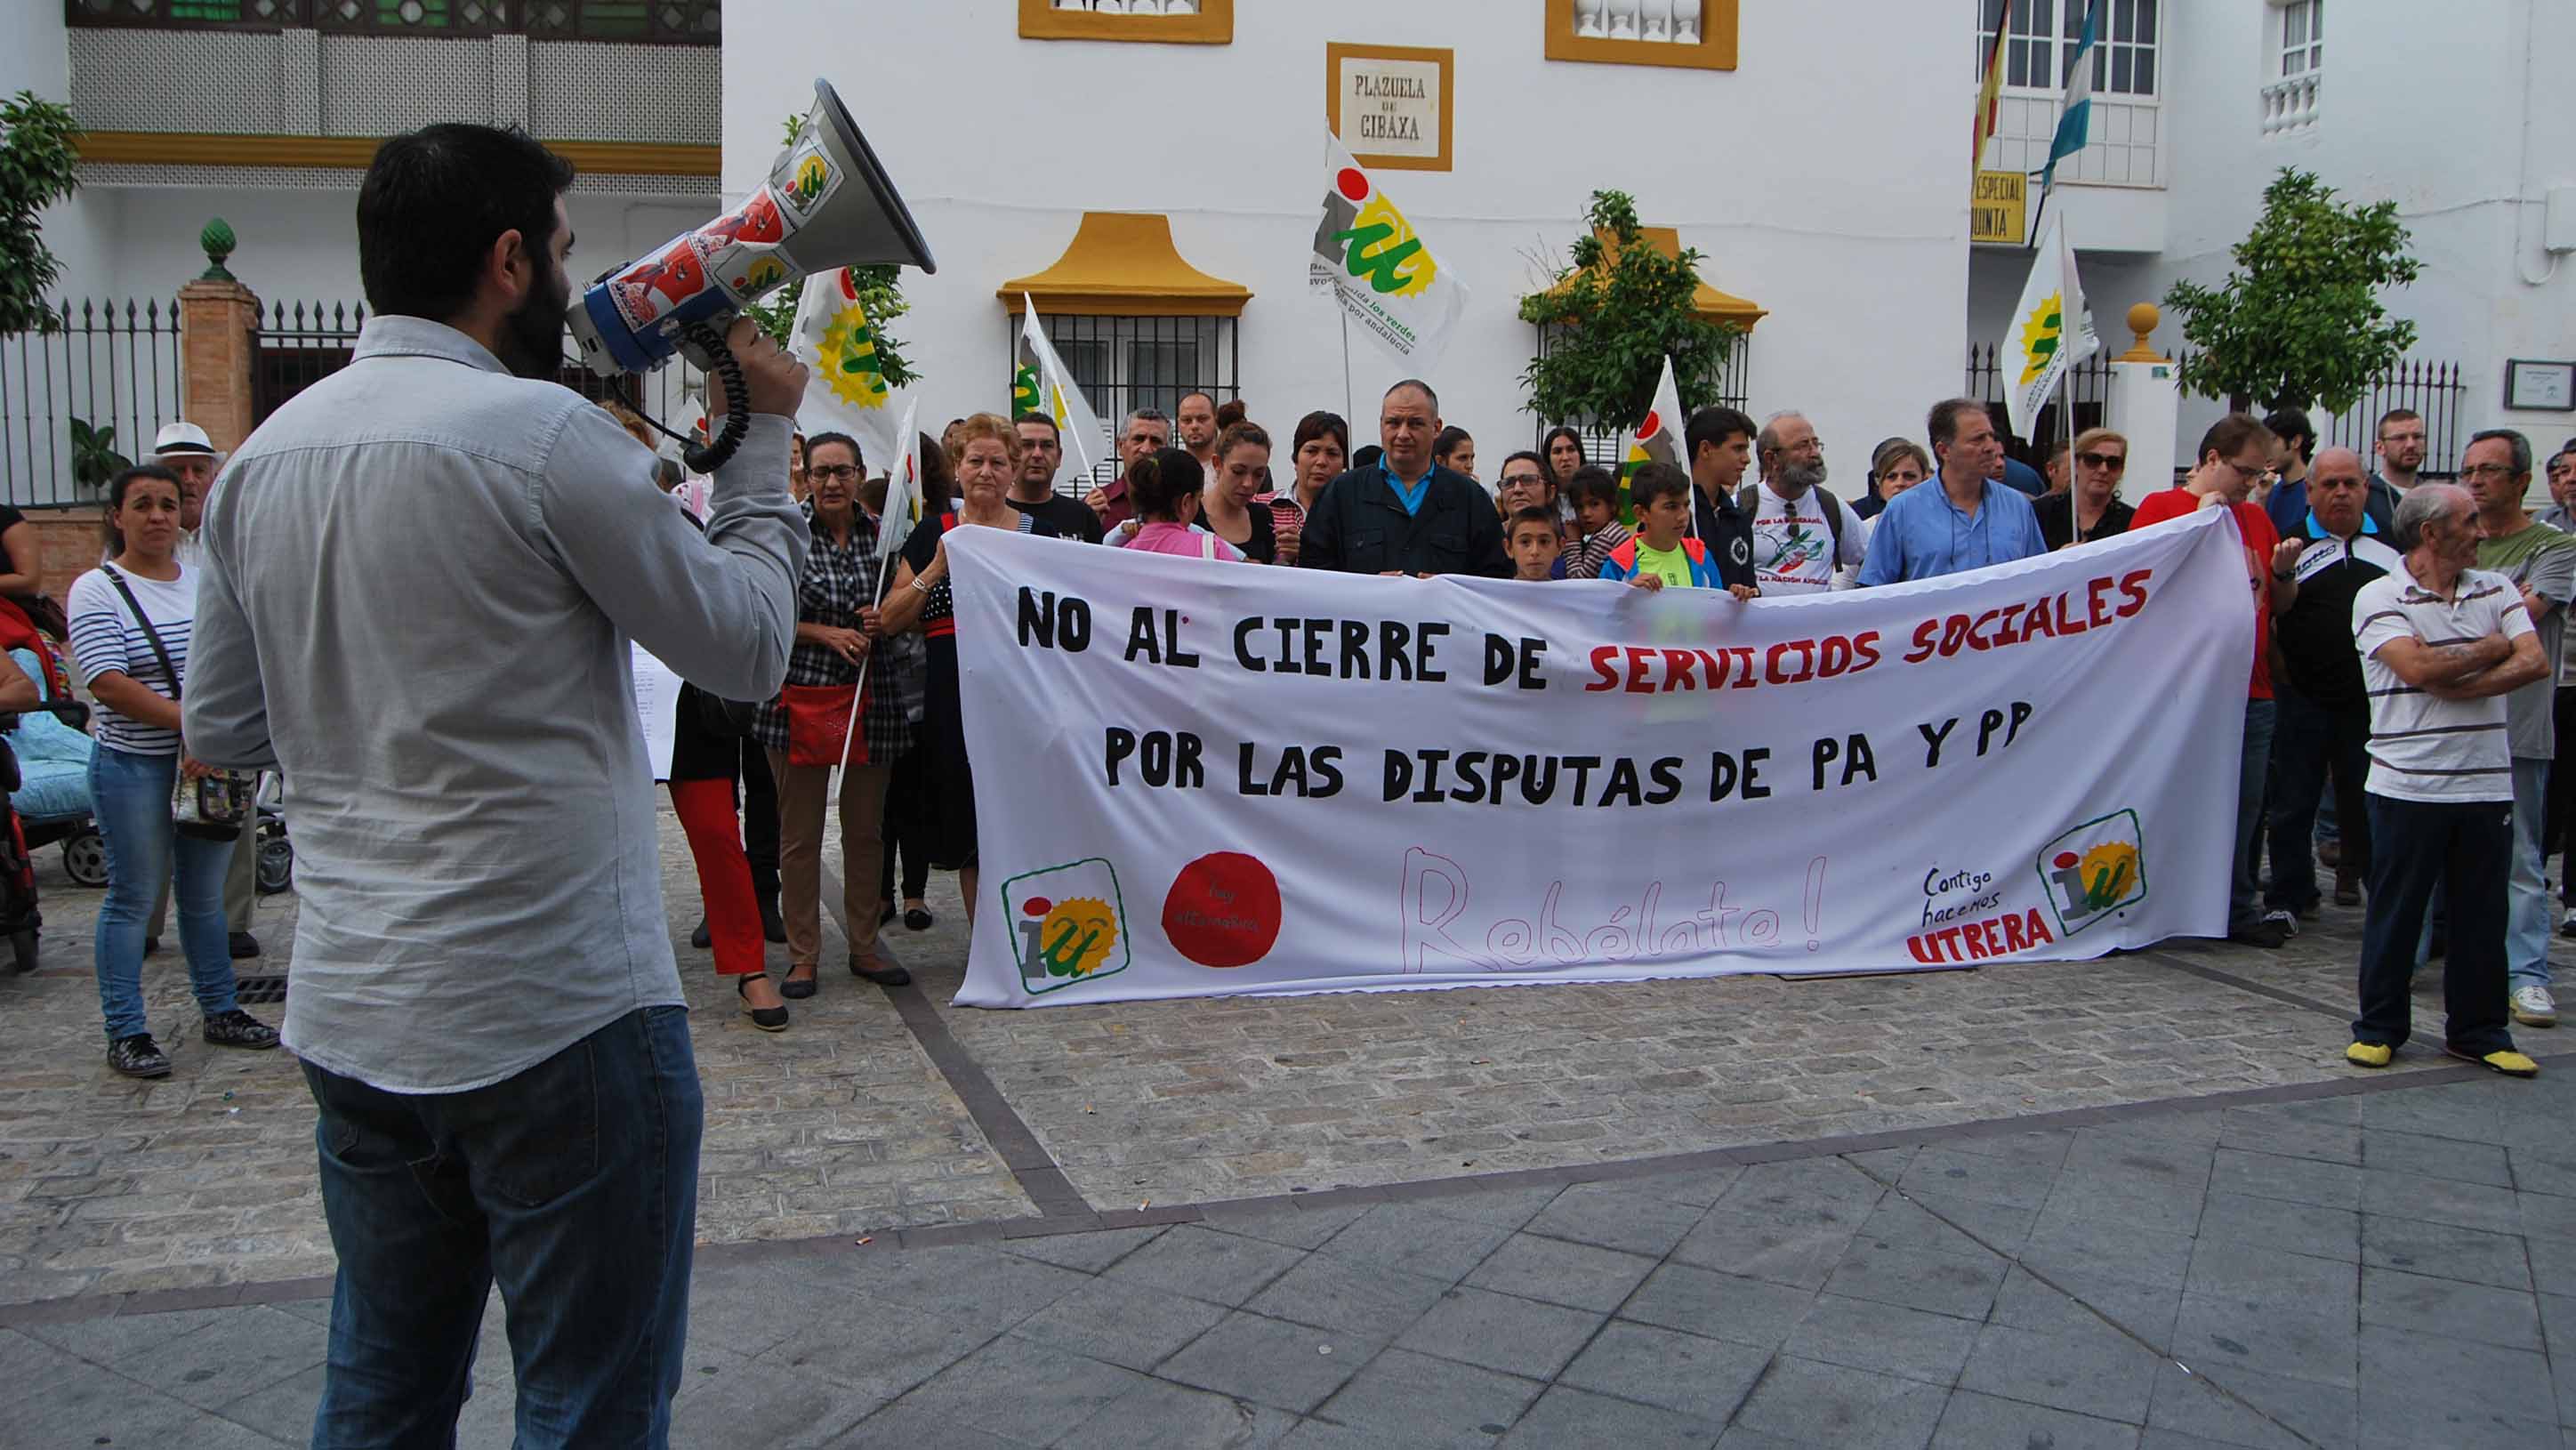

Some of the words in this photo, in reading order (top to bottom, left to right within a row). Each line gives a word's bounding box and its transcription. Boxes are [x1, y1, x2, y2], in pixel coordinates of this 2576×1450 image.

[1355, 75, 1426, 100] PLAZUELA
[1381, 101, 1397, 112] DE
[1361, 114, 1420, 141] GIBAXA
[1970, 206, 2011, 237] UINTA"
[1347, 302, 1365, 320] por
[1385, 314, 1417, 343] verdes
[1018, 585, 1092, 653] NO
[1123, 606, 1201, 668] AL
[1233, 616, 1451, 682] CIERRE
[1484, 632, 1548, 690] DE
[1584, 630, 1881, 694] SERVICIOS
[1903, 568, 2153, 664] SOCIALES
[1106, 727, 1204, 789] POR
[1238, 741, 1344, 799] LAS
[1382, 748, 1685, 807] DISPUTAS
[1709, 747, 1772, 802] DE
[1812, 732, 1878, 791] PA
[1917, 717, 1960, 769] Y
[1976, 701, 2033, 758] PP
[1923, 867, 1992, 897] Contigo
[1906, 906, 2055, 963] UTRERA
